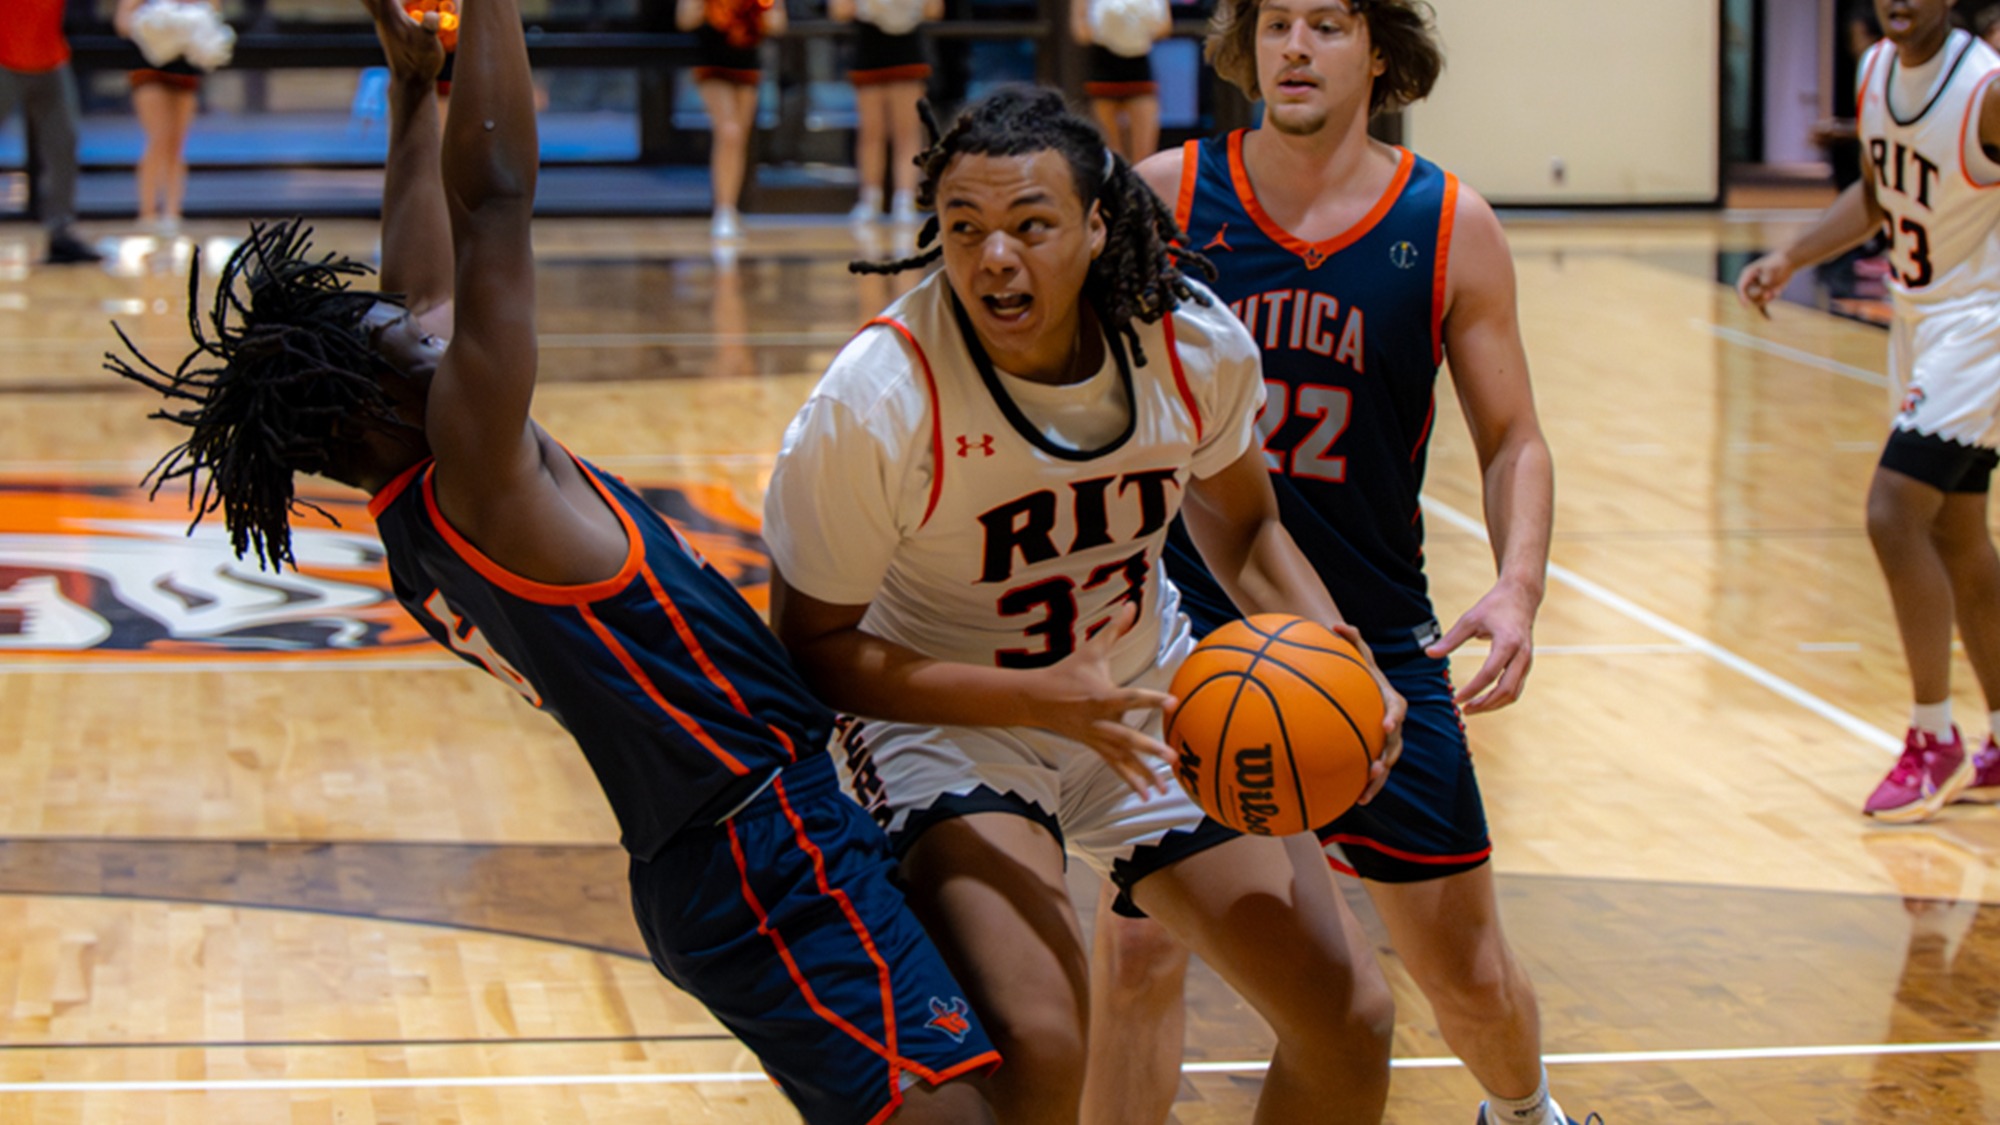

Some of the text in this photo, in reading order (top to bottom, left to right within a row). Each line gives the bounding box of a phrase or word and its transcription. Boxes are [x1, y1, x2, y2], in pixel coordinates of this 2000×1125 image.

[1870, 138, 1939, 212] RIT
[1254, 378, 1353, 483] 22
[968, 467, 1181, 585] RIT
[995, 547, 1150, 670] 33
